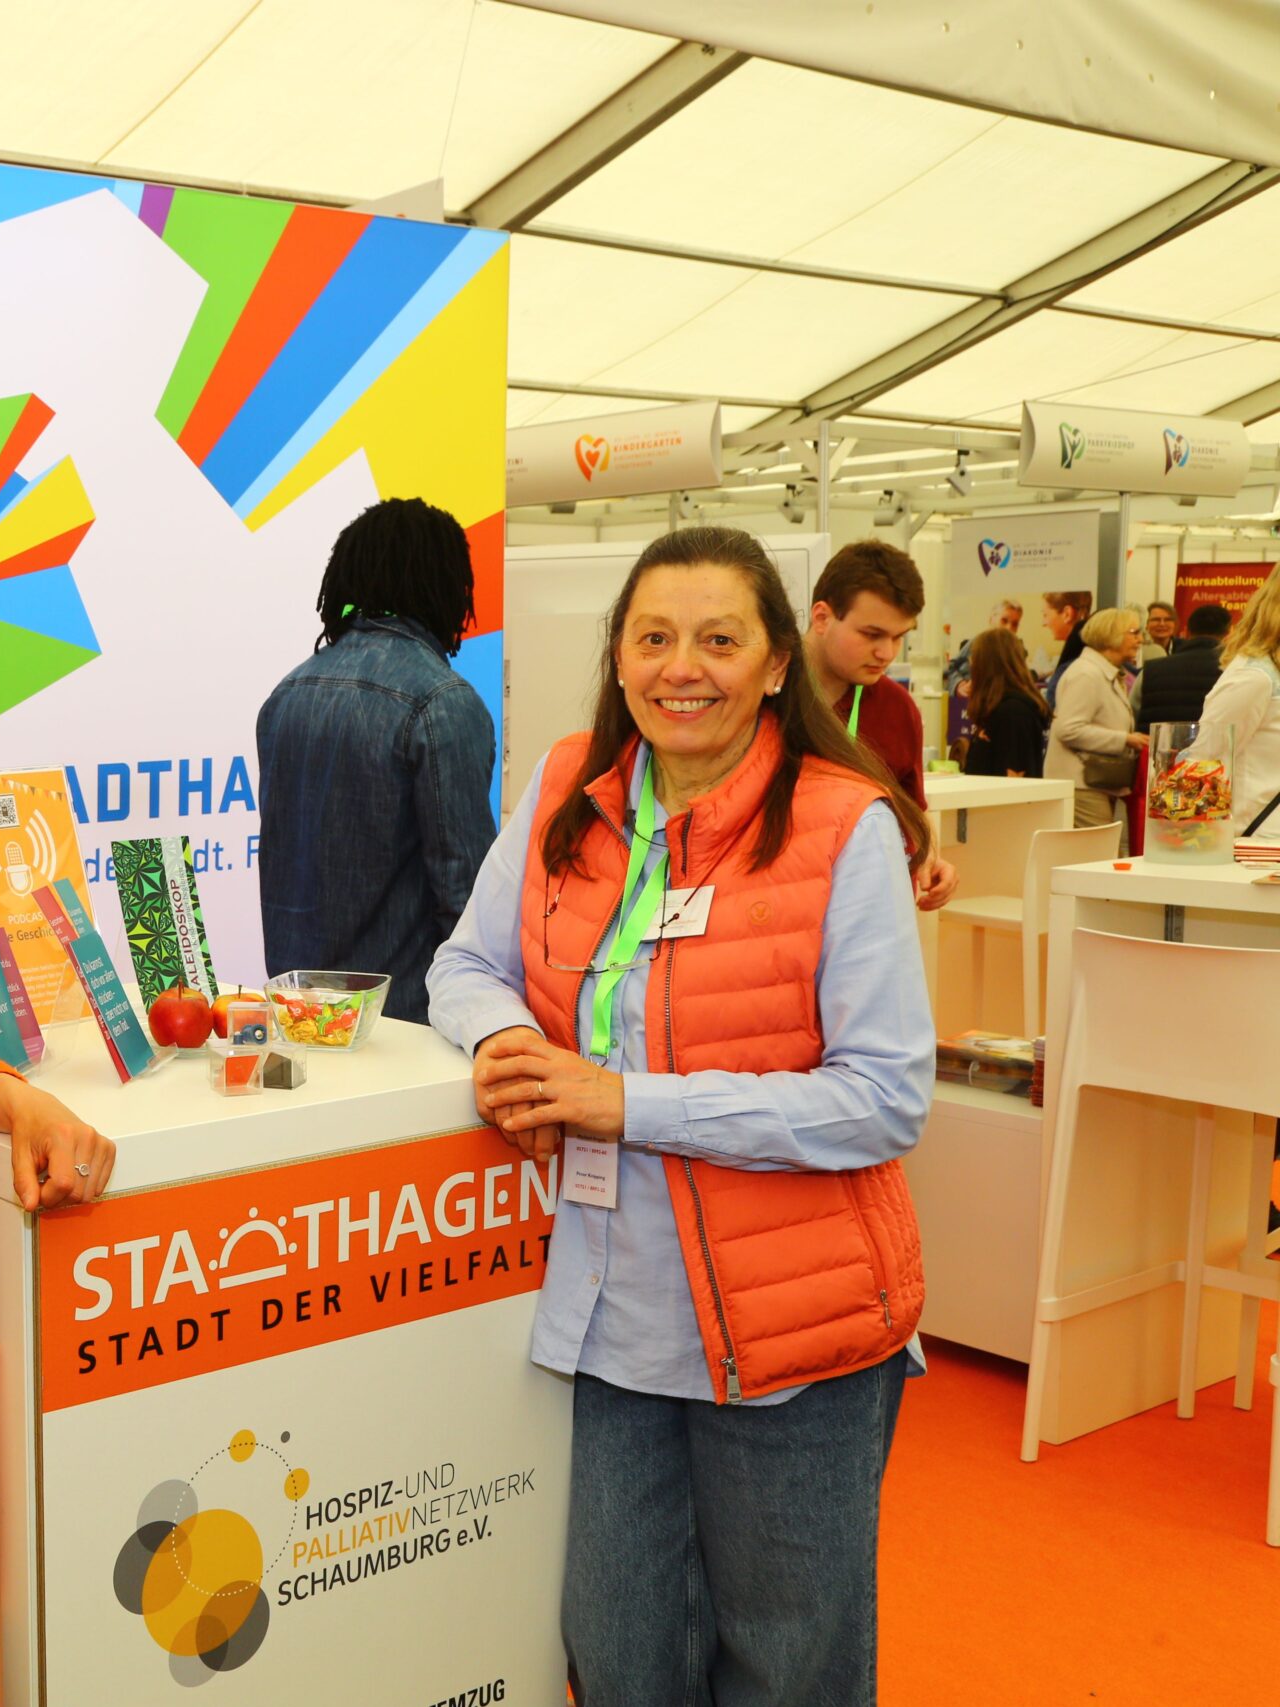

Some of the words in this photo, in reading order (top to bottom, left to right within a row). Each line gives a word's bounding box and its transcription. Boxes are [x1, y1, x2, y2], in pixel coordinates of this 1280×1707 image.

[613, 436, 682, 453] KINDERGARTEN
[1013, 548, 1053, 556] DIAKONIE
[1176, 576, 1265, 587] Altersabteilung
[170, 879, 202, 990] ALEIDOSKOP
[78, 1309, 230, 1374] STADT
[261, 1284, 342, 1331] DER
[370, 1233, 552, 1304] VIELFALT
[292, 1467, 535, 1569] PALLIATIVNETZWERK
[277, 1528, 451, 1606] SCHAUMBURG
[456, 1515, 493, 1547] e.V.
[429, 1678, 505, 1707] MZUG
